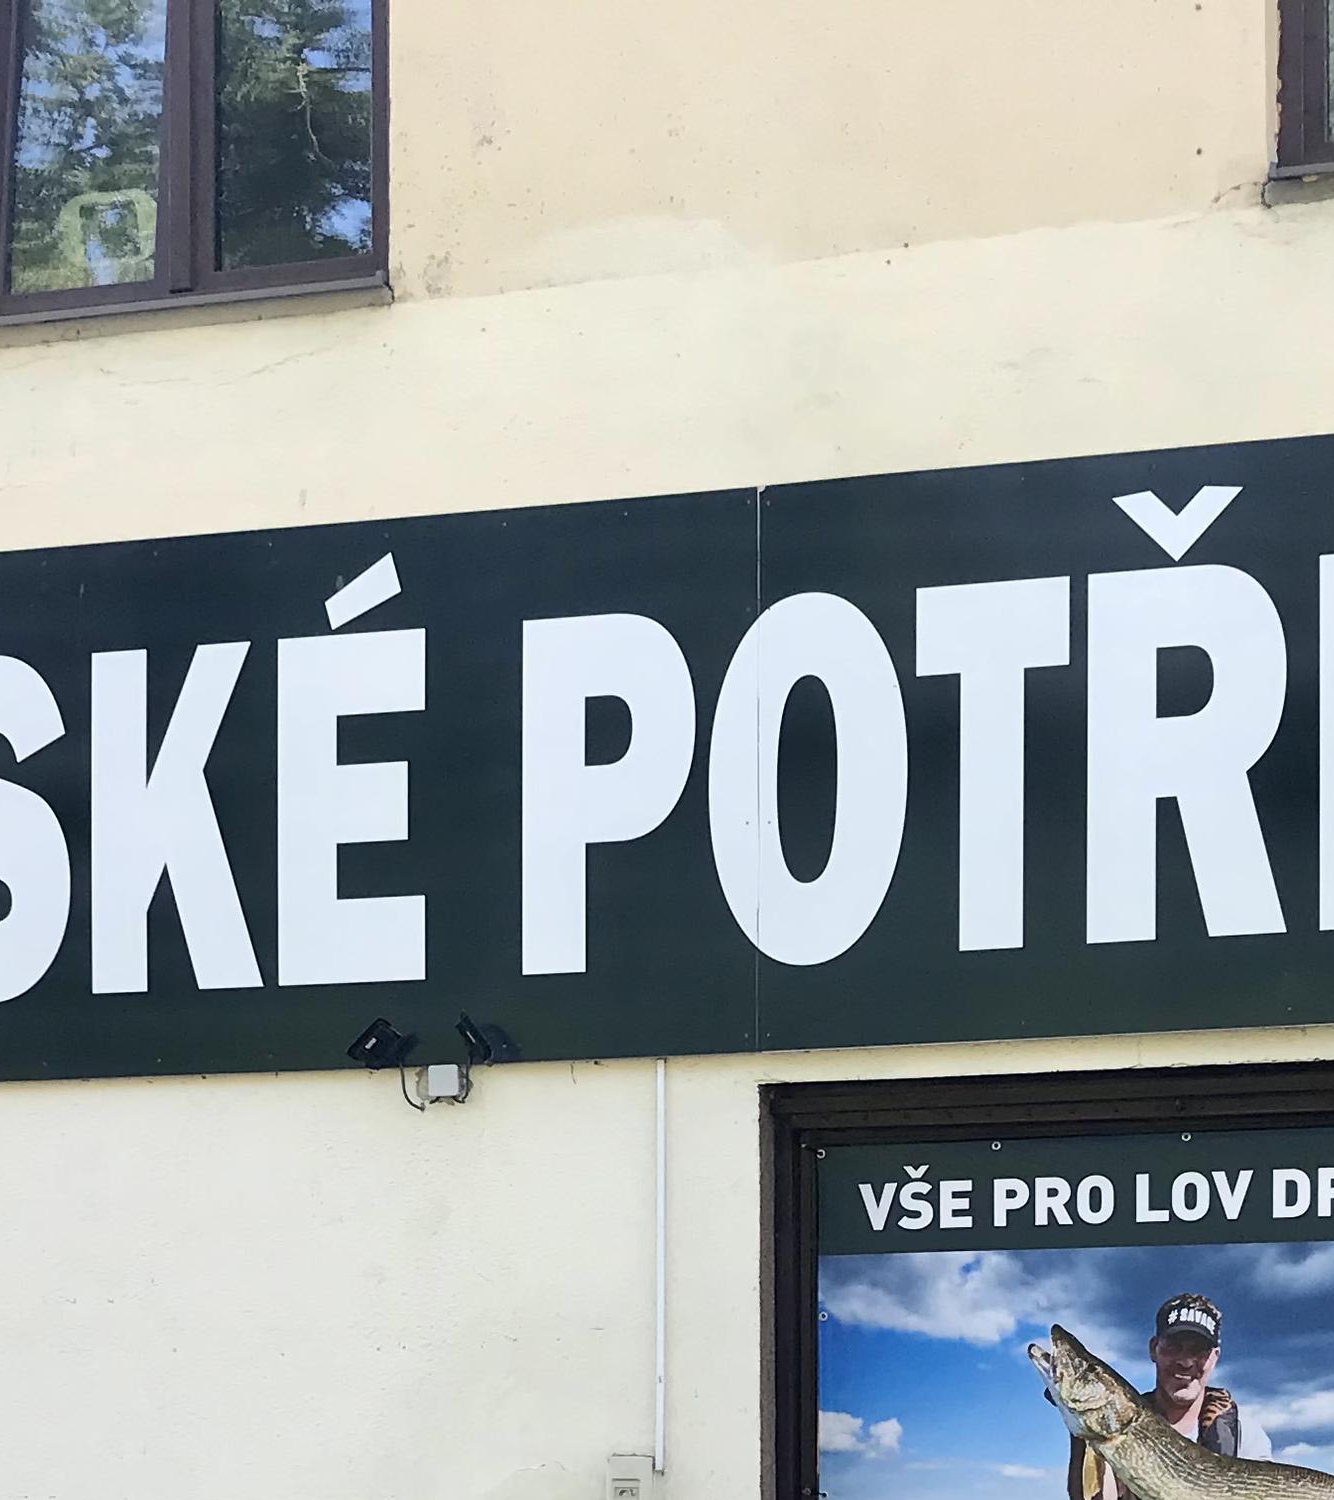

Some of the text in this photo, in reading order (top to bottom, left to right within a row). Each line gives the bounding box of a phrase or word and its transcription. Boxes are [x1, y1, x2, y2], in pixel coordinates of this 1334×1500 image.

[859, 1165, 973, 1231] VŠE
[993, 1174, 1116, 1227] PRO
[1135, 1169, 1254, 1222] LOV
